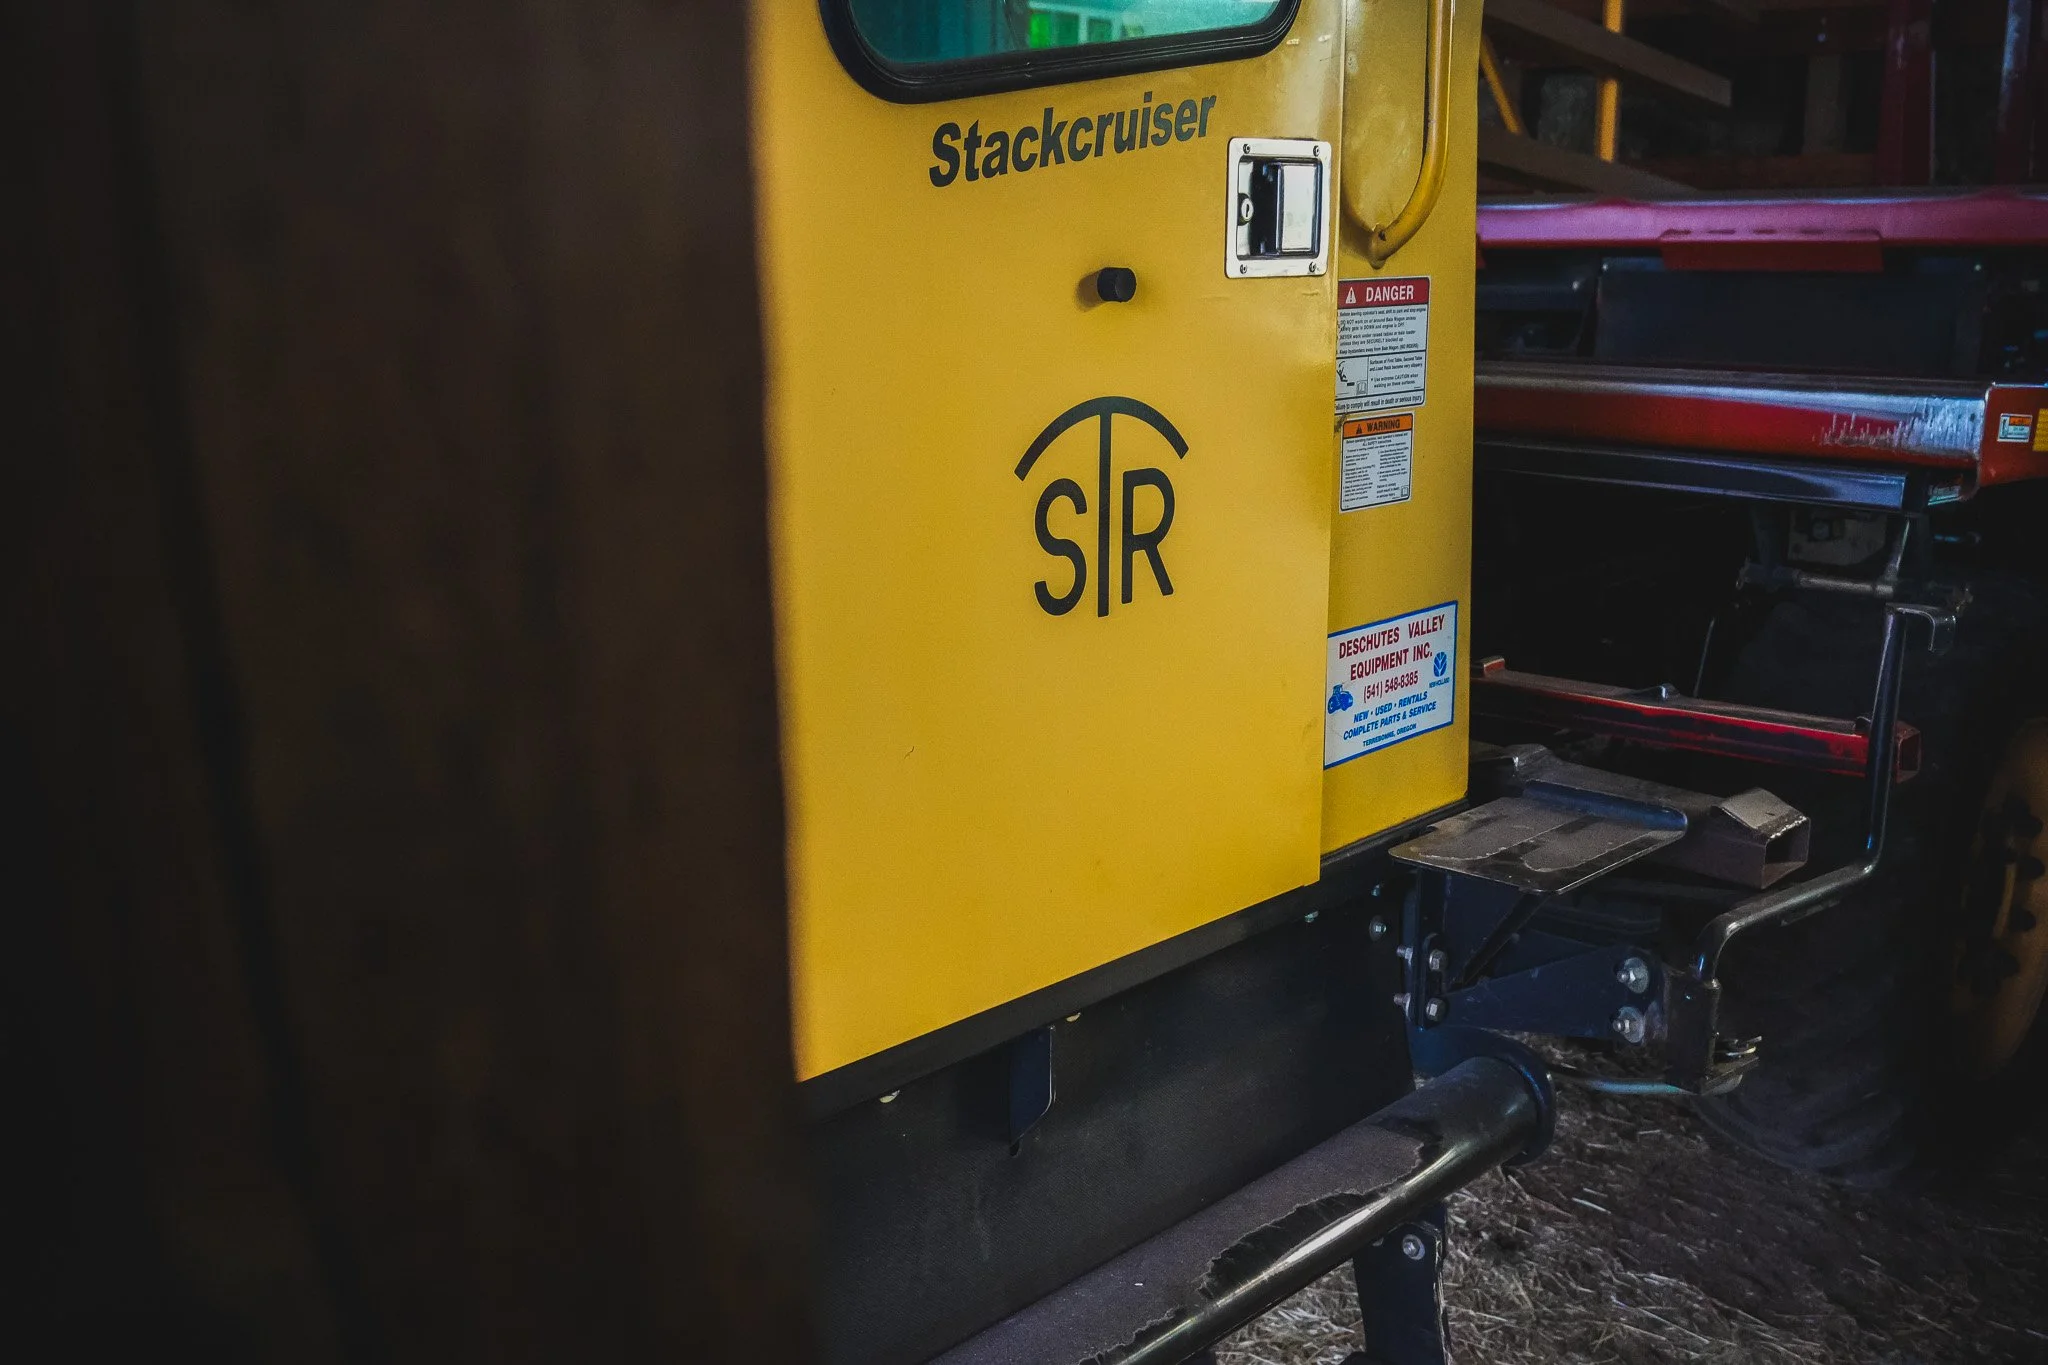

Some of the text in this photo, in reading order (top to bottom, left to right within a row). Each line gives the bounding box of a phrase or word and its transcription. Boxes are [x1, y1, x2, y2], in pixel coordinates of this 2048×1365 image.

[929, 91, 1216, 187] Stackcruiser
[1366, 285, 1413, 302] DANGER
[1367, 419, 1400, 432] WARNING
[1339, 614, 1445, 659] DESCHUTES VALLEY
[1350, 643, 1433, 681] EQUIPMENT INC.
[1363, 670, 1419, 703] (541) 548-8385
[1343, 701, 1437, 740] COMPLETE PARTS & SERVICE
[1353, 691, 1428, 723] NEW USED RENTALS
[1396, 723, 1417, 736] OREGON
